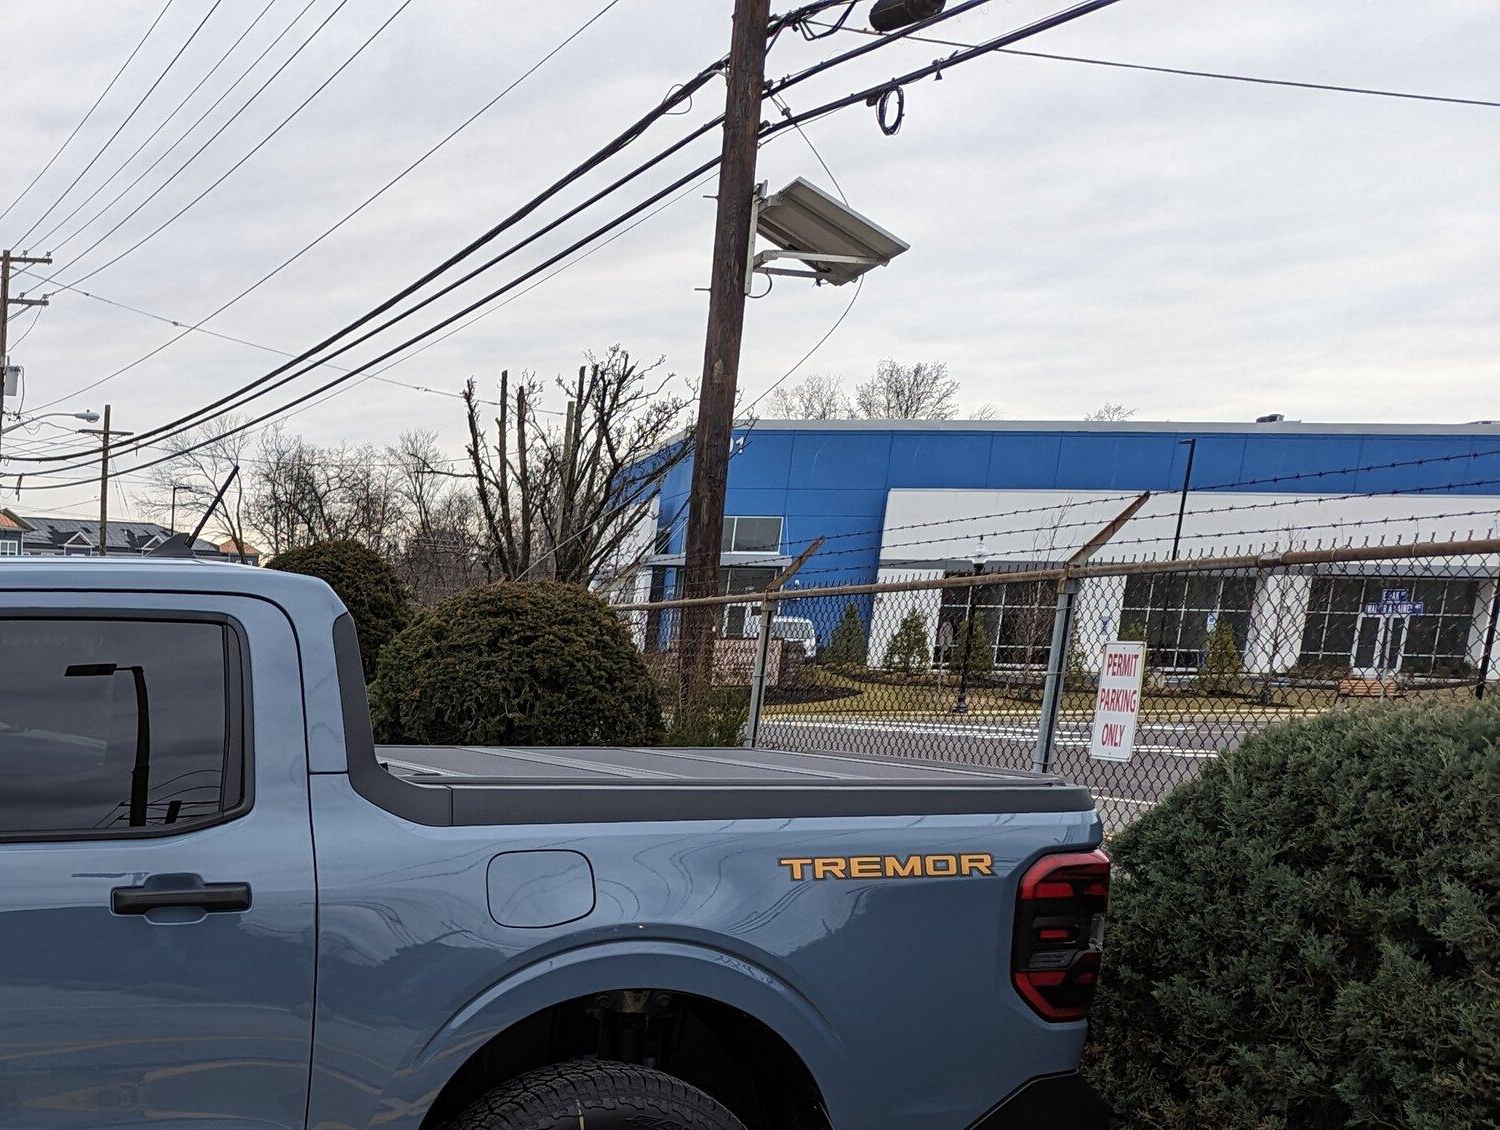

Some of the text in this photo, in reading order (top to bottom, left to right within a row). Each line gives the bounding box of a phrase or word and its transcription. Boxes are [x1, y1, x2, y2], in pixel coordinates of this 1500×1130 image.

[1106, 653, 1139, 677] PERMIT
[1099, 688, 1138, 713] PARKING
[1101, 723, 1125, 748] ONLY
[778, 853, 997, 881] TREMOR
